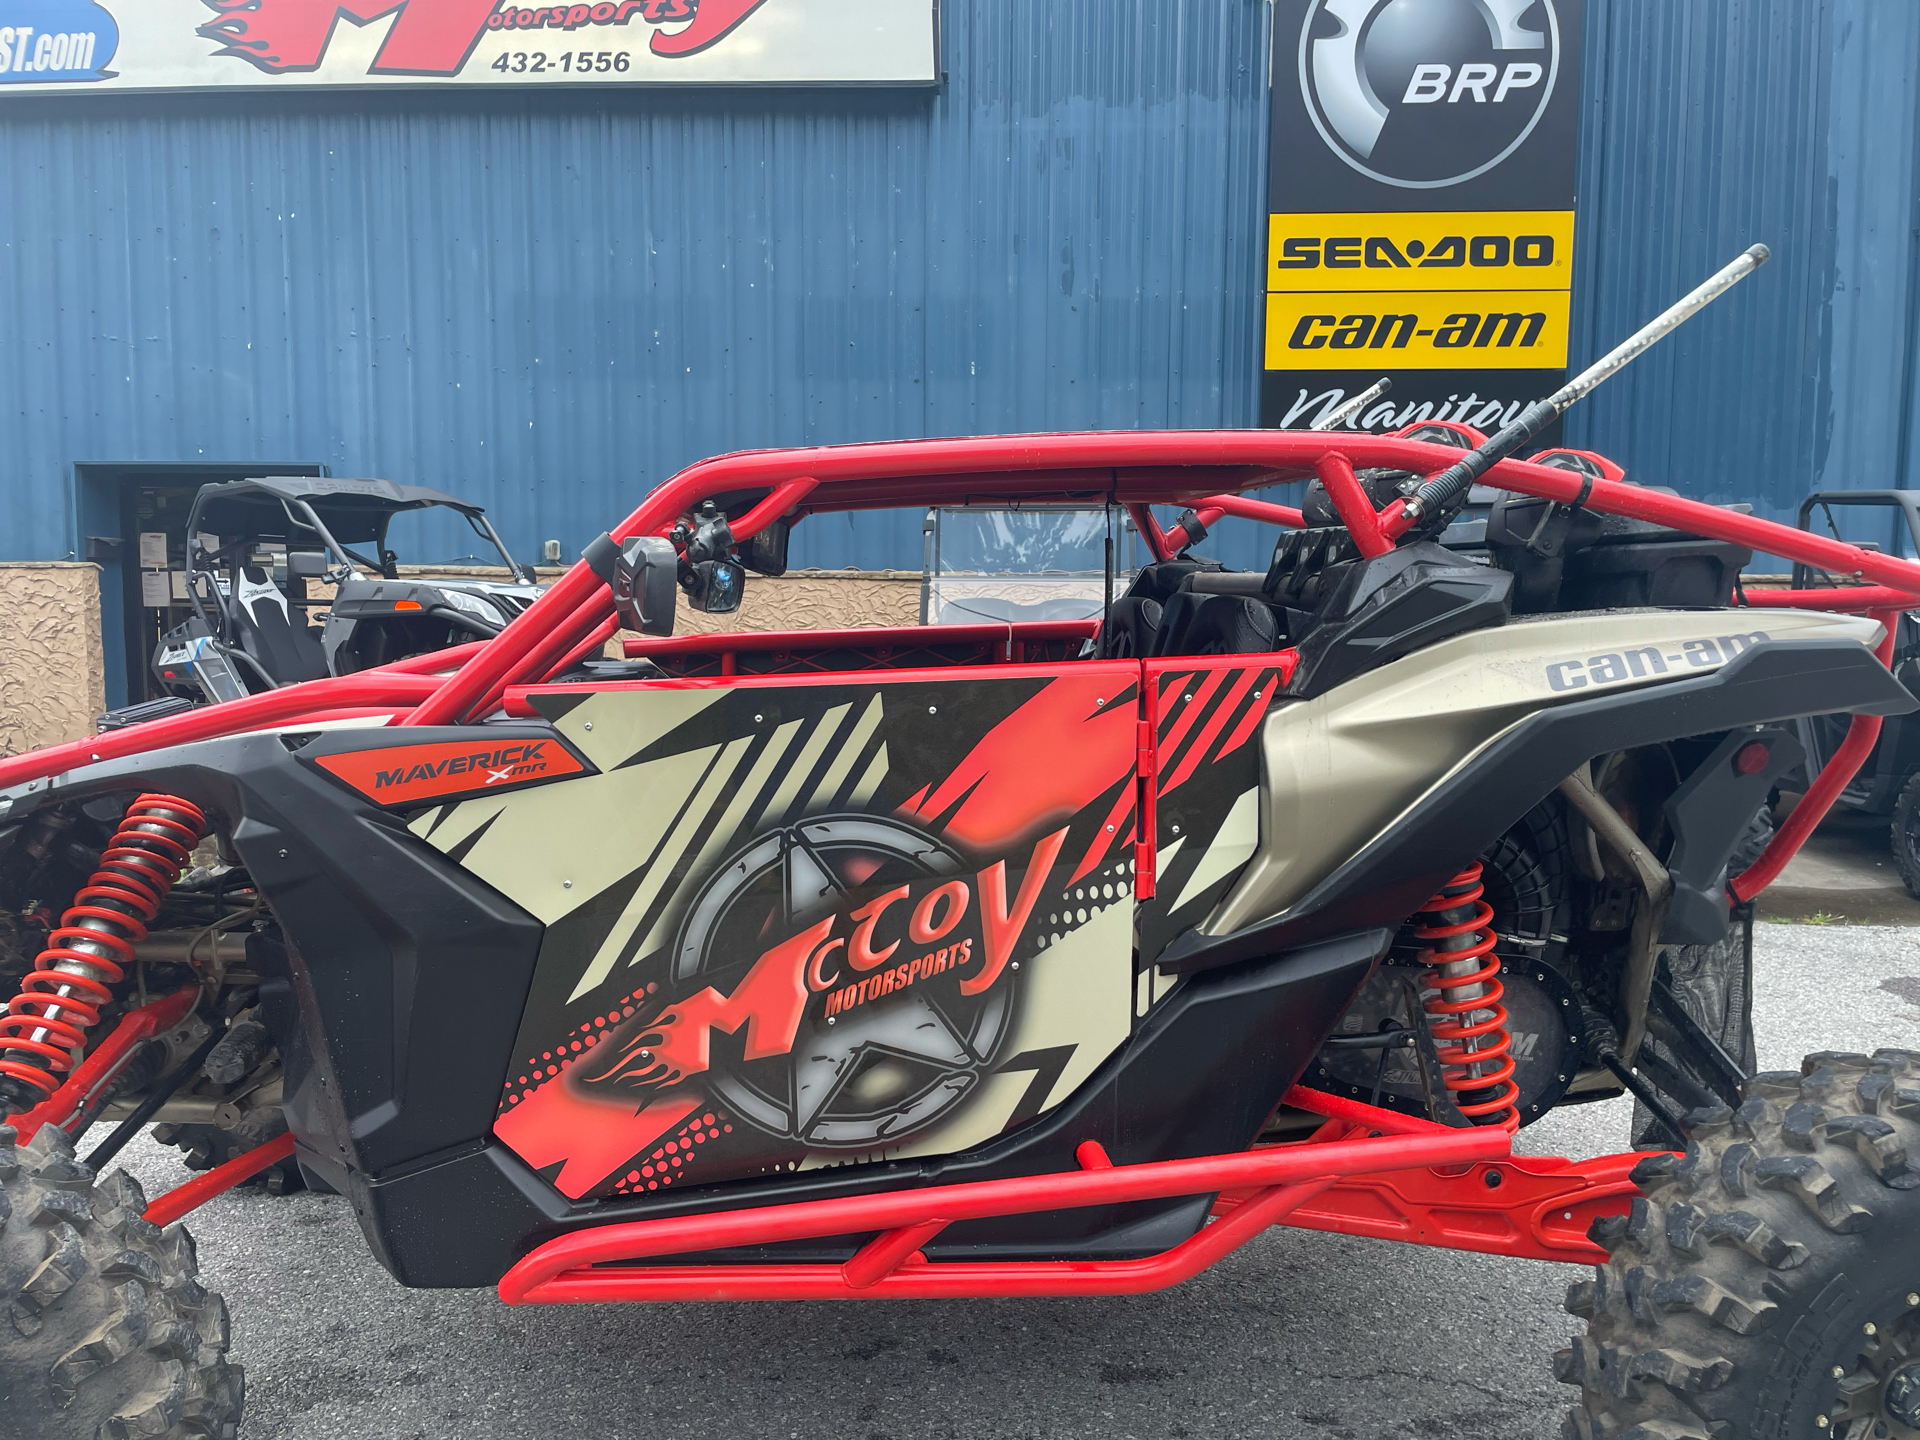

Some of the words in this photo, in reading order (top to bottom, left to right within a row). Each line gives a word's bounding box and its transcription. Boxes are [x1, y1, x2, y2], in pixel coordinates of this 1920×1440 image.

[491, 51, 631, 73] 432-1556
[1402, 63, 1543, 103] BRP
[1288, 312, 1547, 349] can-am
[1546, 631, 1771, 692] can-am
[375, 742, 548, 788] MAVERICK
[824, 937, 973, 1019] MOTORSPORTS
